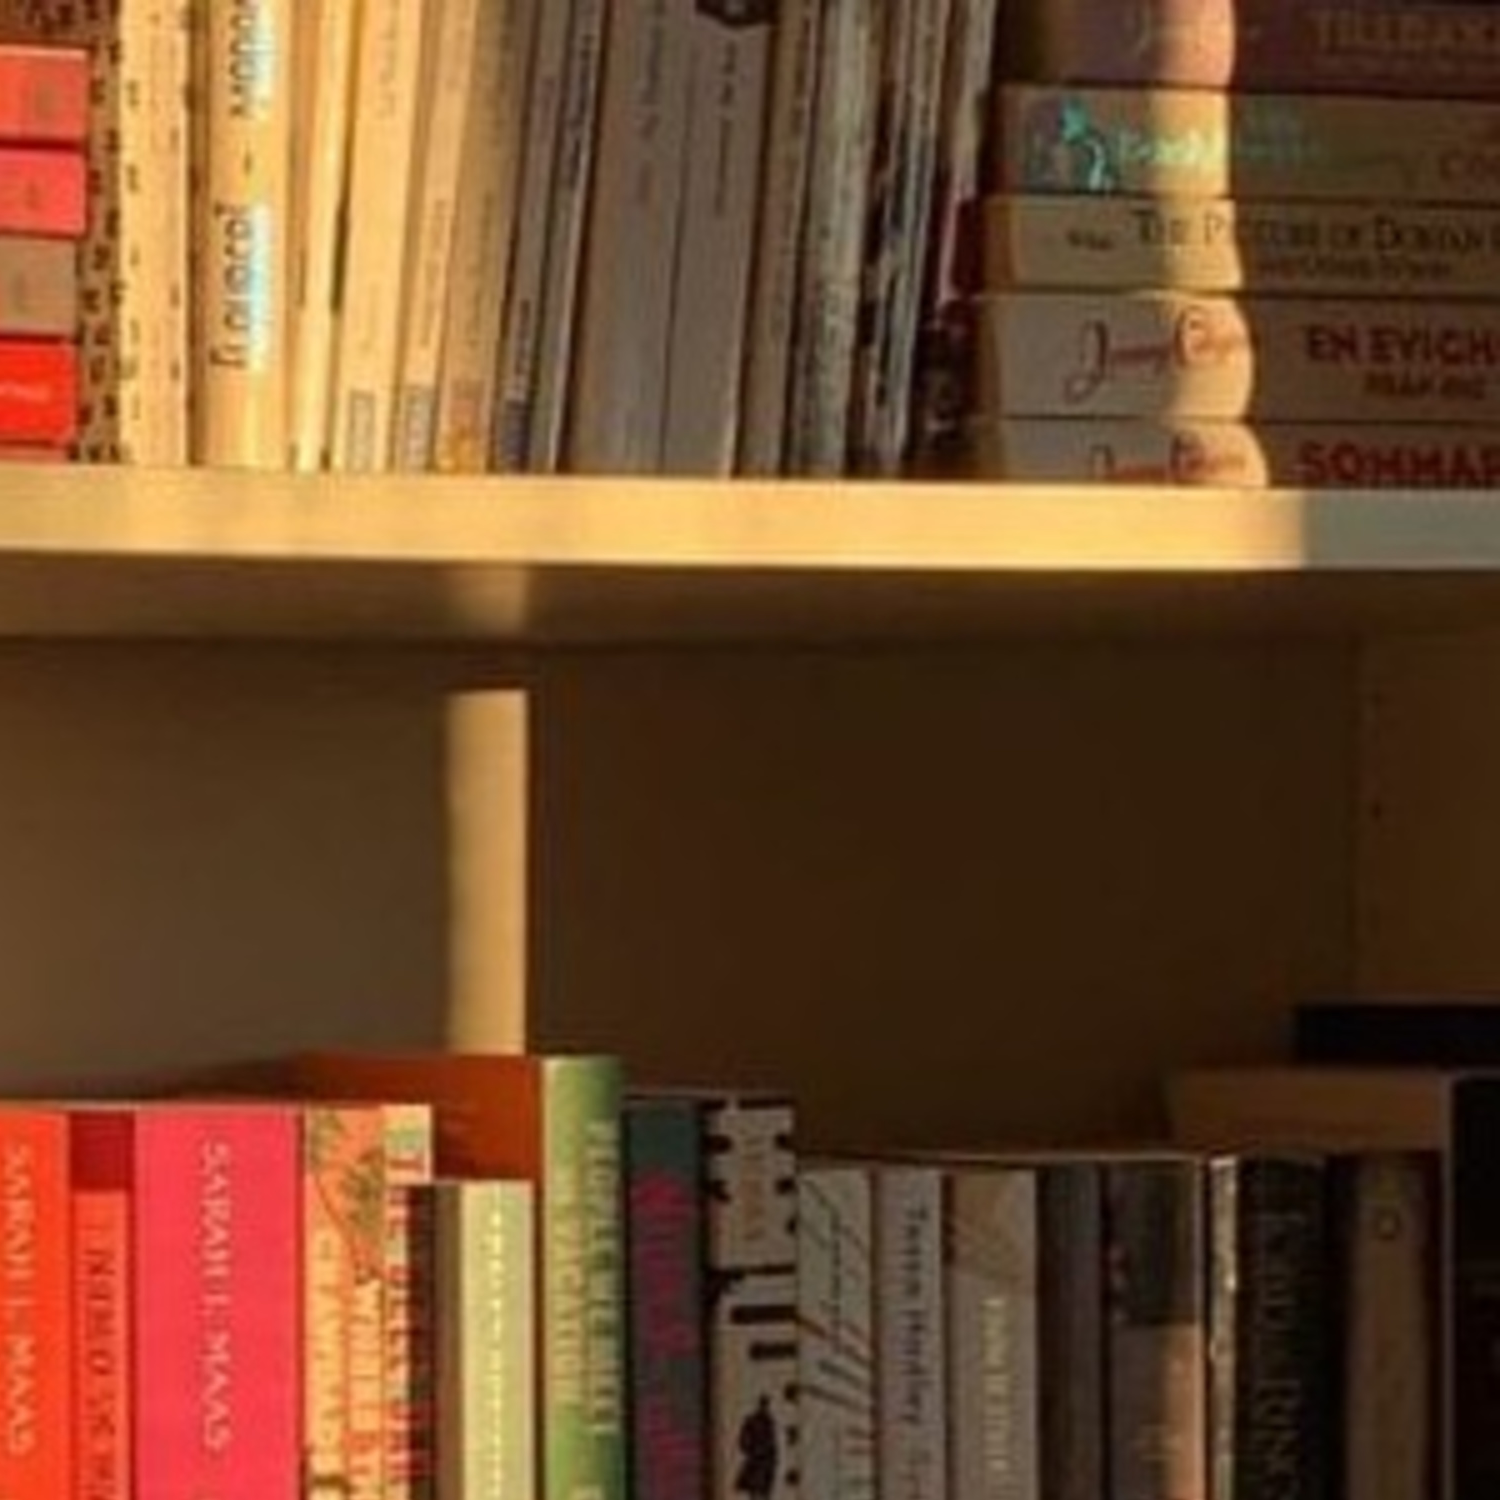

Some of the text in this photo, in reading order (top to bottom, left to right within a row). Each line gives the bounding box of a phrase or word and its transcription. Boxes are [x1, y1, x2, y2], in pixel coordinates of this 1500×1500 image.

[3, 1144, 36, 1279] SARAH
[202, 1139, 236, 1283] SARAH
[586, 1118, 622, 1436] PEOPLE WE MEET
[552, 1218, 585, 1406] VACATION
[4, 1332, 37, 1456] MAAS
[202, 1332, 236, 1451] MAAS
